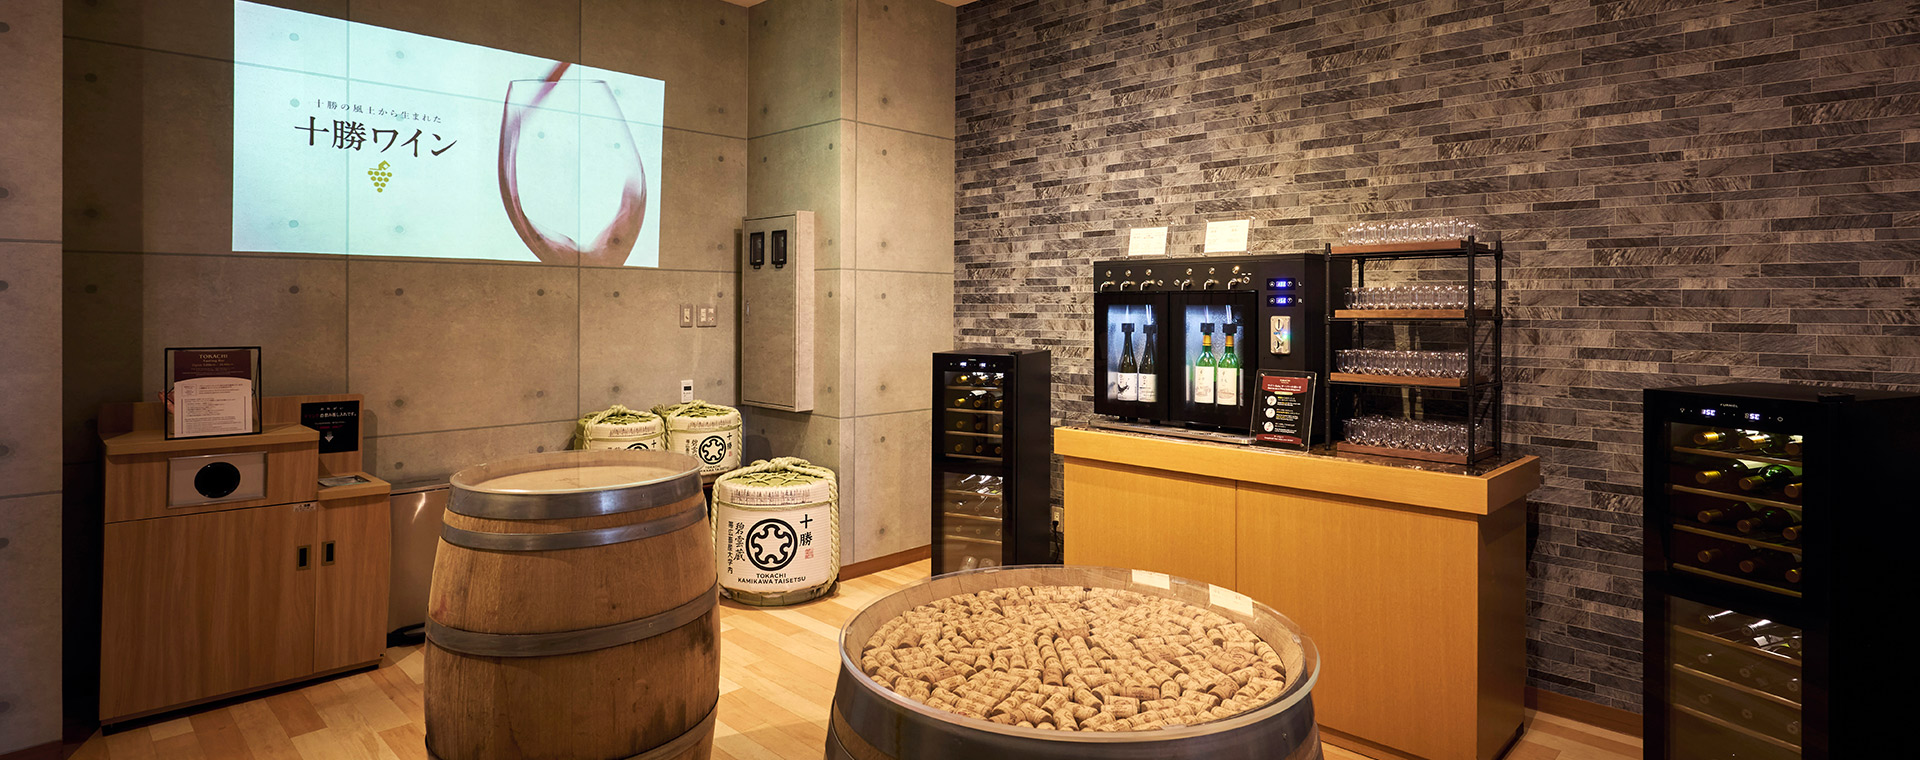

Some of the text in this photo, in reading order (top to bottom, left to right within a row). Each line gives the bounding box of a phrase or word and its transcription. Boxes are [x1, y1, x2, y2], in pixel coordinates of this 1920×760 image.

[315, 98, 442, 124] 十勝の風土から生まれた
[294, 116, 458, 158] 十勝ワイン
[800, 514, 813, 547] 十勝
[737, 575, 807, 585] KAMIKAWA TAISETSU
